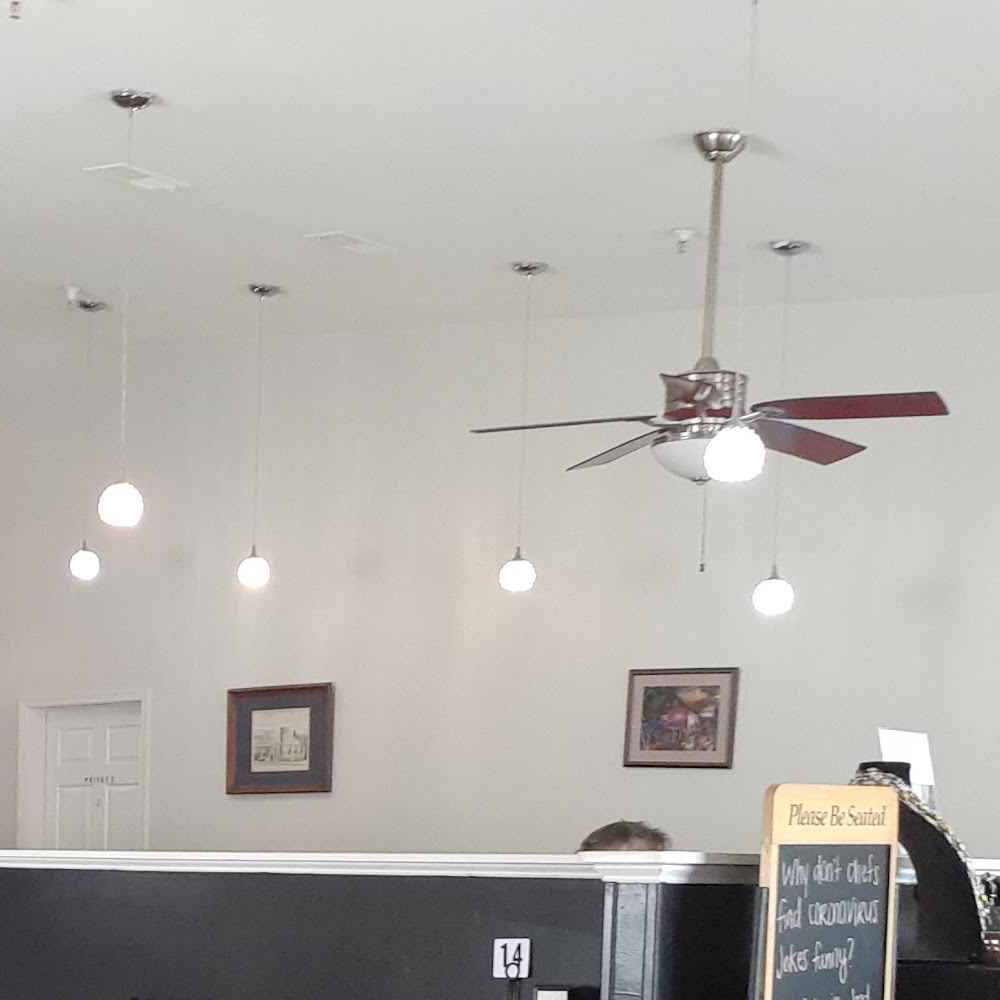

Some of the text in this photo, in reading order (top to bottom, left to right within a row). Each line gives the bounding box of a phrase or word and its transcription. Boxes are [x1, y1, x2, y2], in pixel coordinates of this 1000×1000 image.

[788, 803, 887, 826] Please Be Seated
[781, 858, 810, 898] Why
[812, 855, 842, 884] don't
[500, 943, 522, 968] 14
[812, 937, 855, 984] funny?
